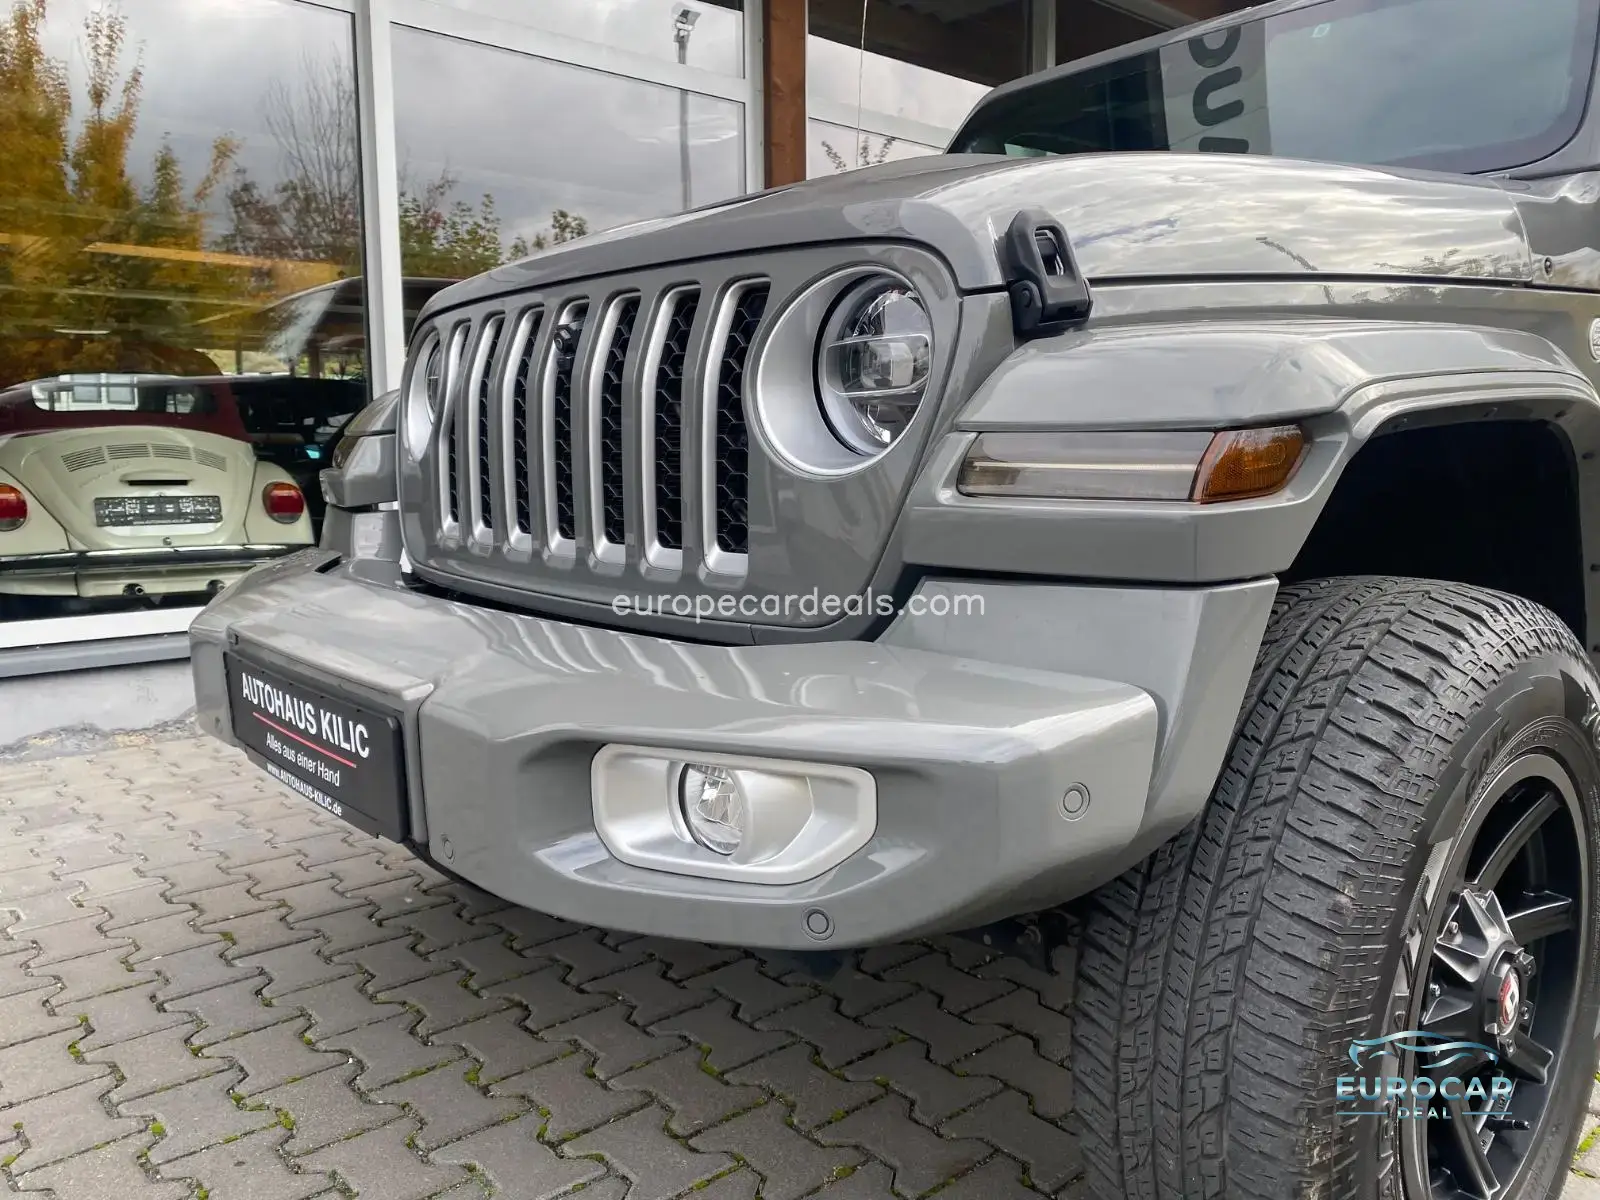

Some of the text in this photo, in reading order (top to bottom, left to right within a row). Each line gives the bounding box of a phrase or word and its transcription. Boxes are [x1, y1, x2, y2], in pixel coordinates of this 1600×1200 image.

[242, 672, 370, 758] AUTOHAUS KILIC
[266, 732, 340, 787] Alles aus einer Hand
